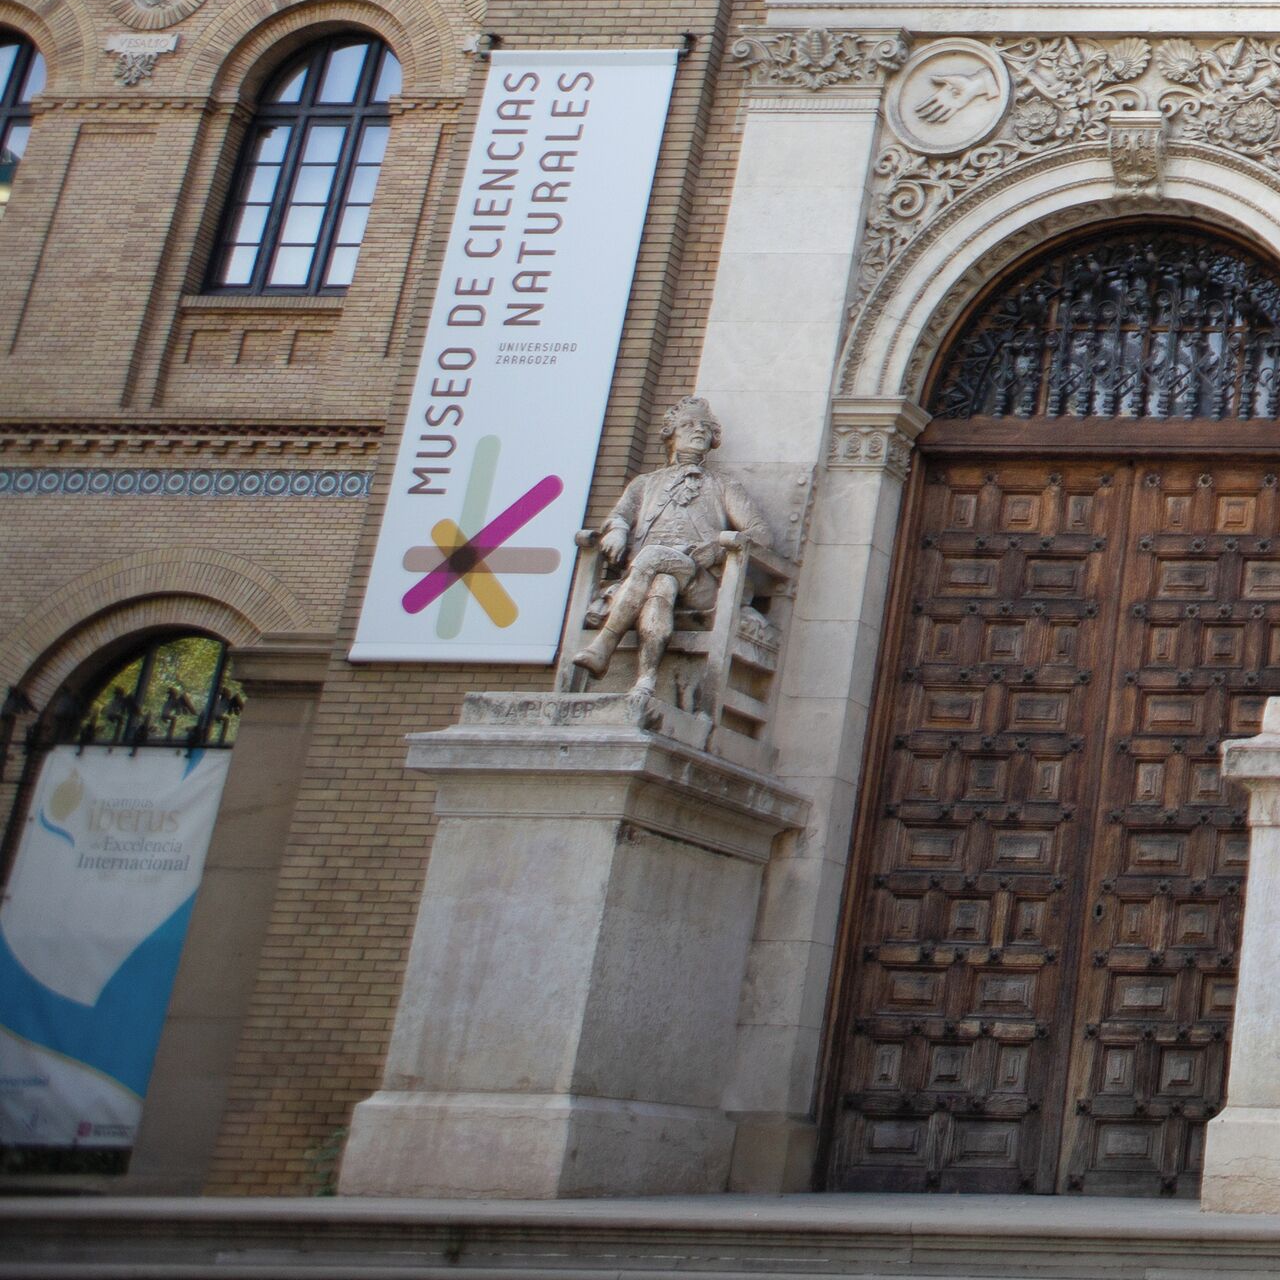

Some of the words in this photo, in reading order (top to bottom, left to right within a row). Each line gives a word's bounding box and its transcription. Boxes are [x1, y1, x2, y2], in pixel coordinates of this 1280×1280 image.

[464, 72, 541, 258] CIENCIAS
[503, 71, 595, 327] NATURALES
[447, 277, 495, 327] DE
[495, 355, 558, 365] ZARAGOZA
[498, 342, 578, 352] UNIVERSIDAD
[407, 346, 477, 496] MUSEO
[103, 836, 183, 853] Excelencia
[77, 853, 191, 871] Internacional
